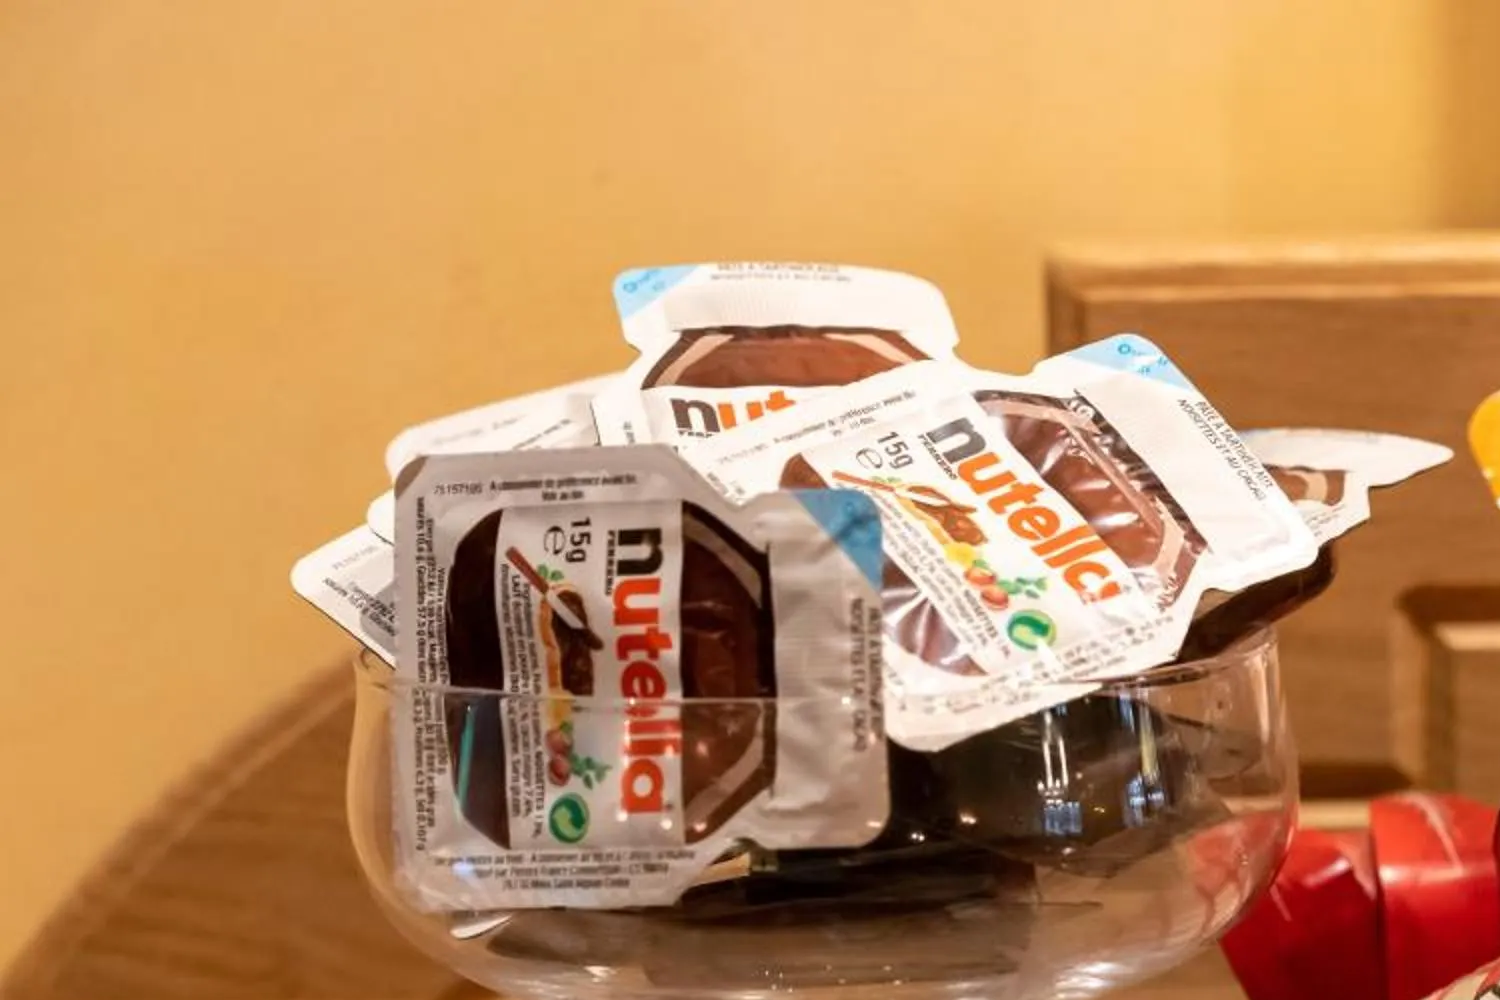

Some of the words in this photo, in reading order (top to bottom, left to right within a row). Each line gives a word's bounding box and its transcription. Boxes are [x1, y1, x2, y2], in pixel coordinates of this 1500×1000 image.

[877, 430, 914, 470] 15g
[565, 516, 592, 564] 15g
[926, 417, 1122, 605] nutella
[612, 527, 682, 814] nutella
